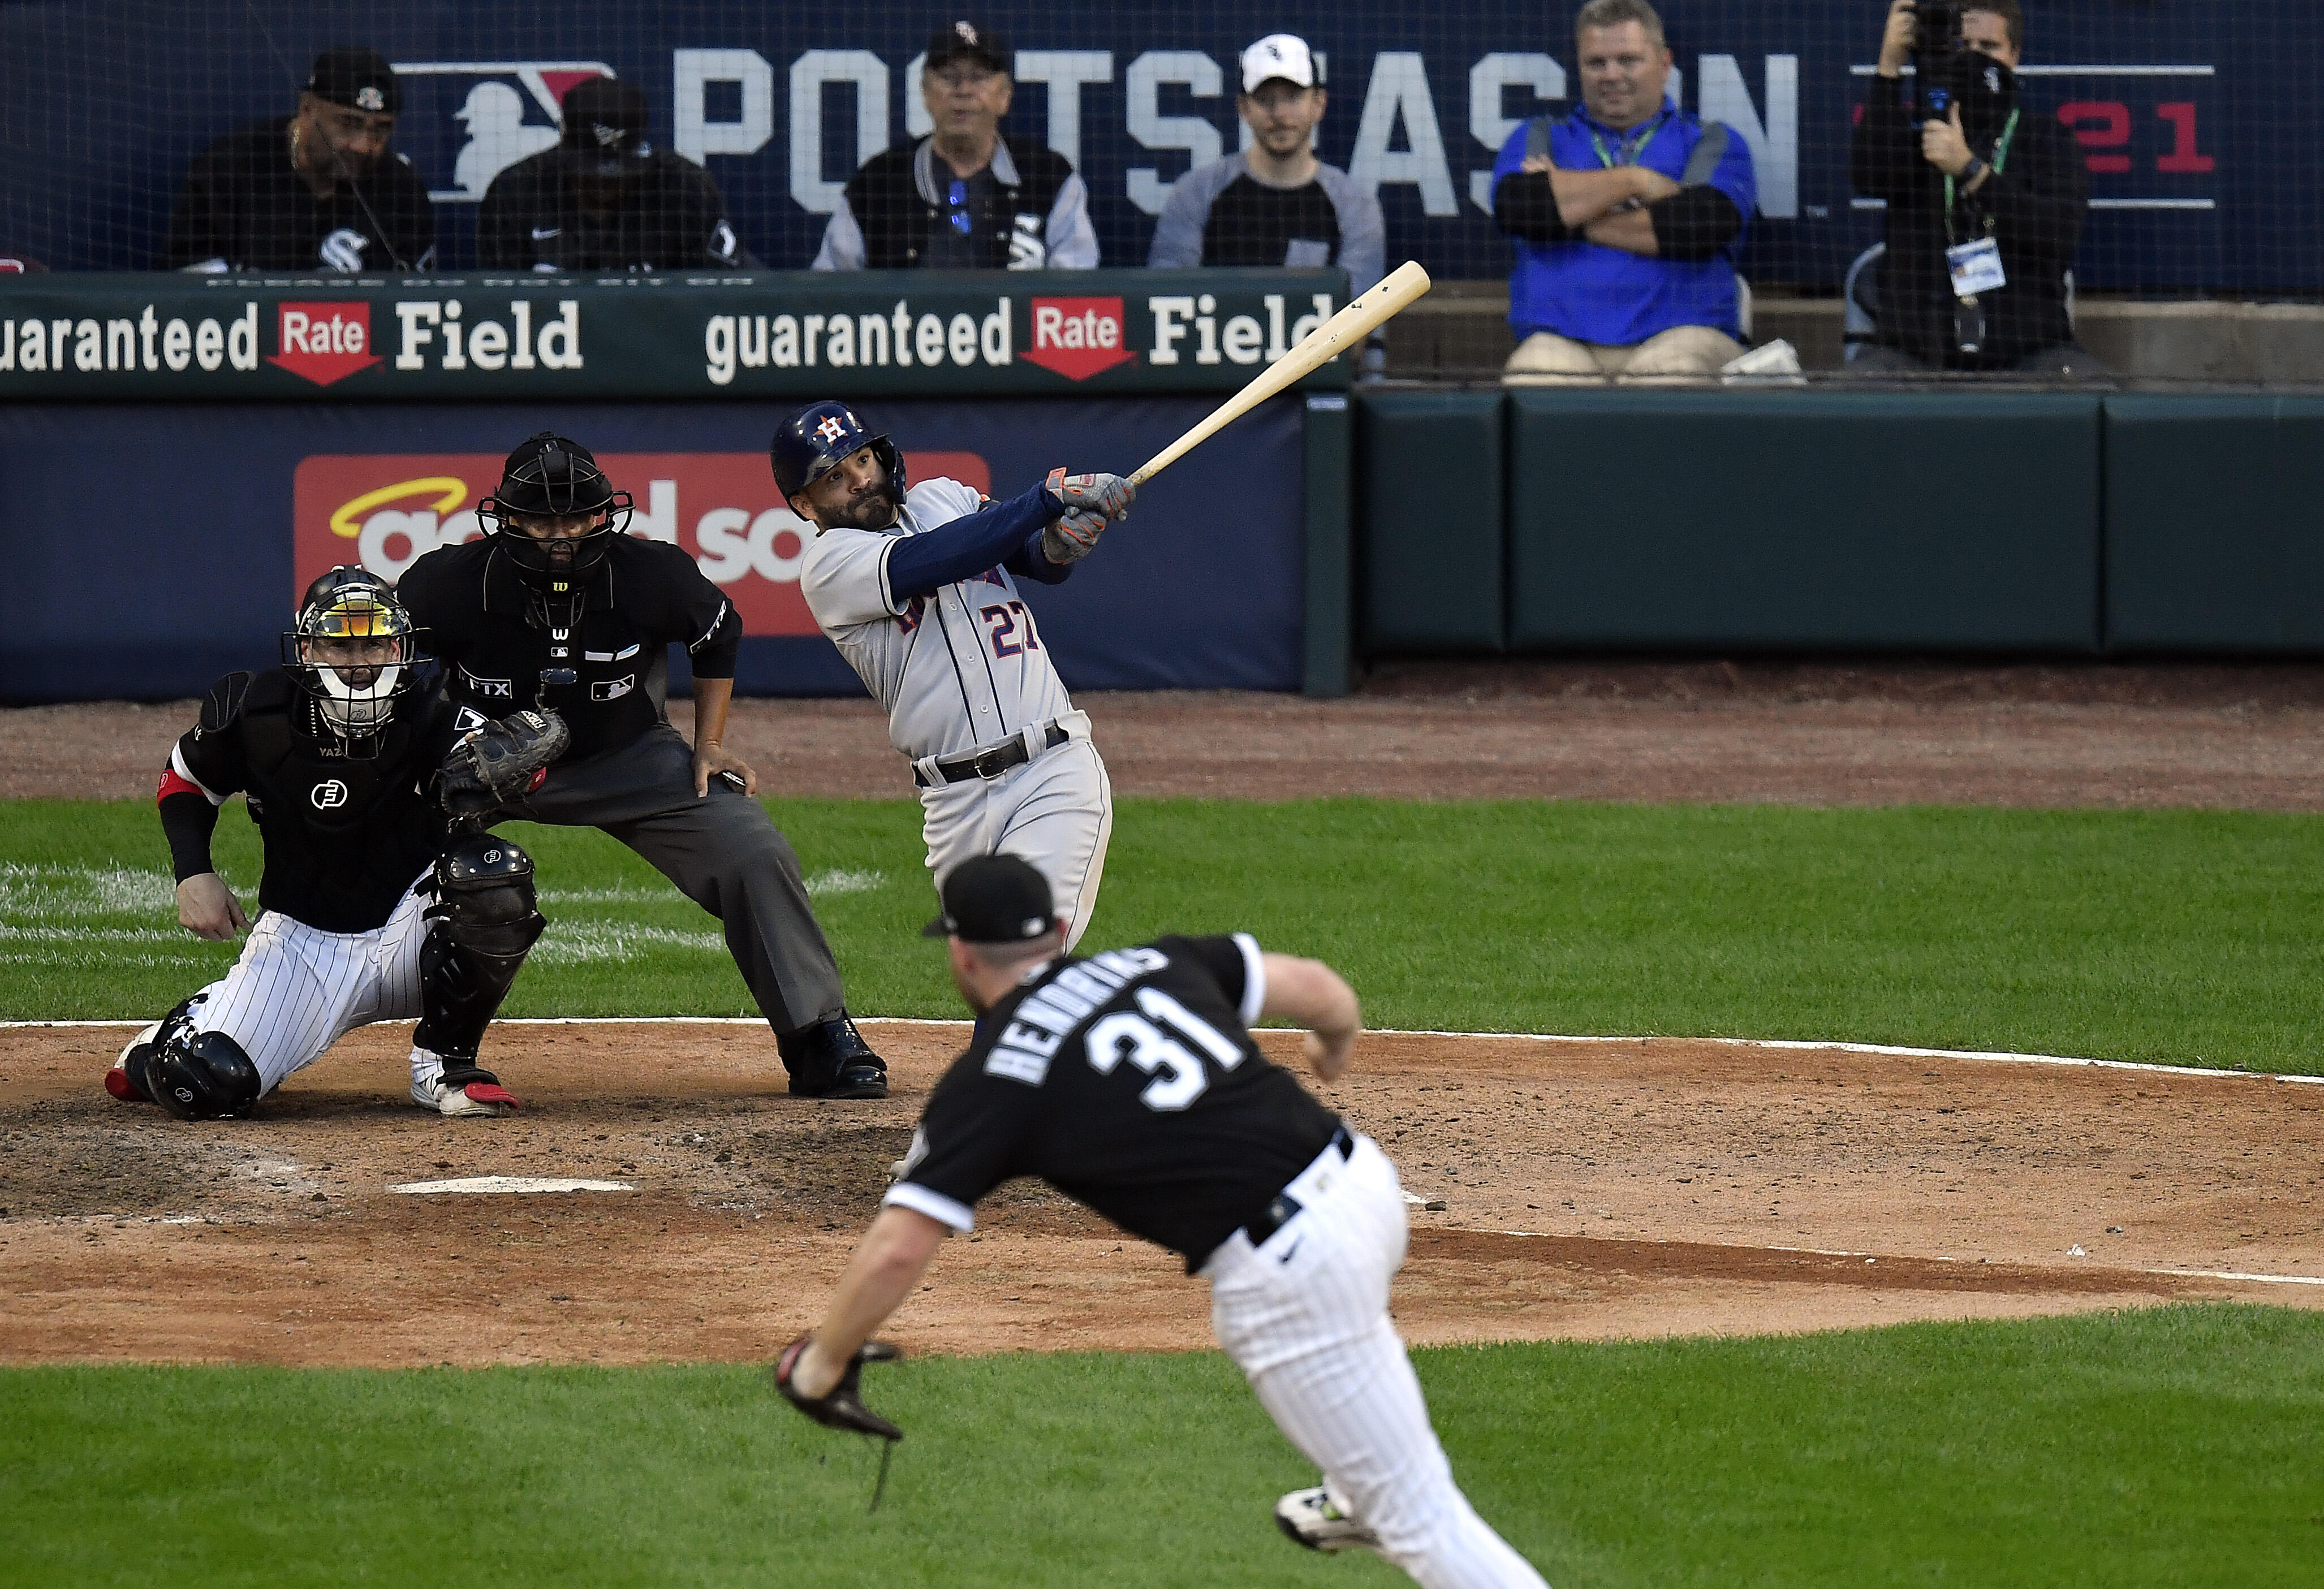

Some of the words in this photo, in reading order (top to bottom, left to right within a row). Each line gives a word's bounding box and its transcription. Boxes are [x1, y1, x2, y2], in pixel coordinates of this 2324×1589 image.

[674, 49, 1799, 219] POTSASN
[283, 311, 364, 354] Rate
[395, 300, 584, 370] Field
[705, 299, 1012, 386] guaranteed
[1036, 306, 1119, 349] Rate
[980, 601, 1039, 664] 27
[469, 678, 509, 696] FTX
[1084, 986, 1246, 1113] 31
